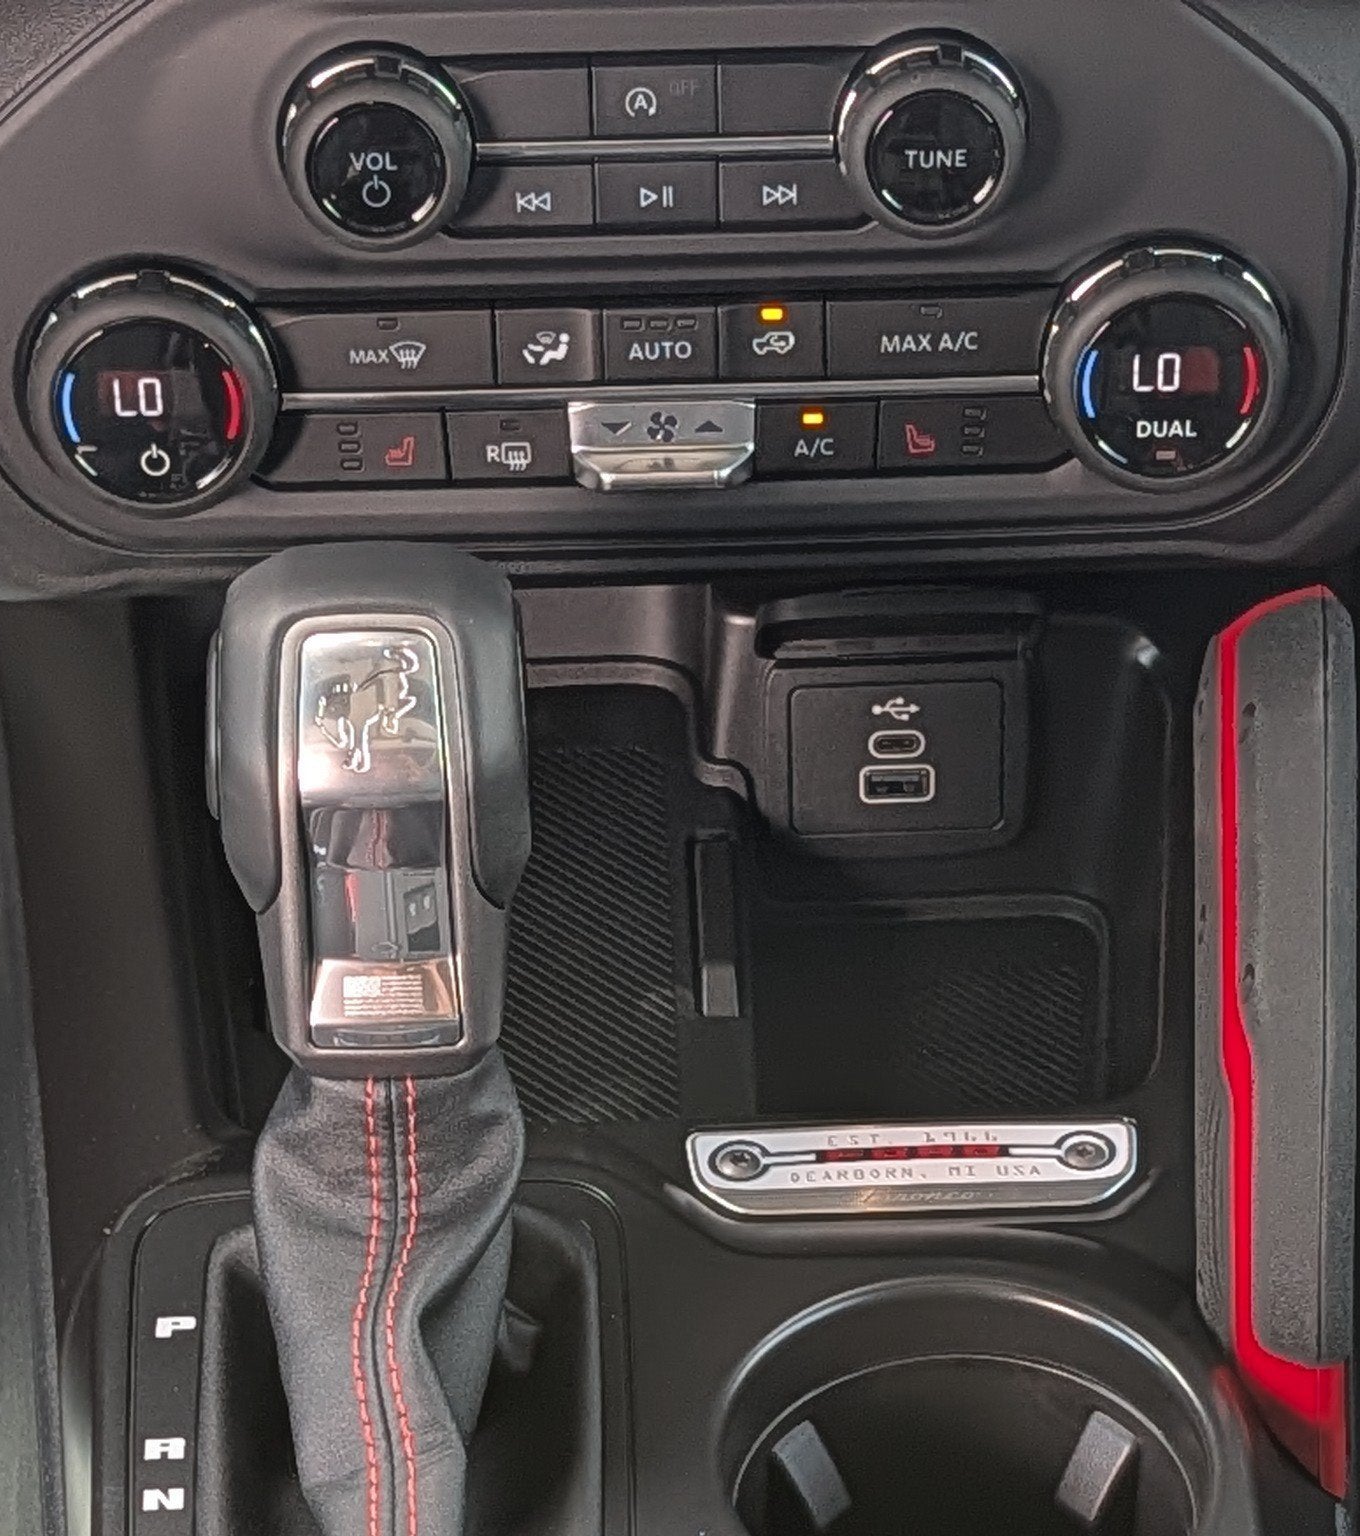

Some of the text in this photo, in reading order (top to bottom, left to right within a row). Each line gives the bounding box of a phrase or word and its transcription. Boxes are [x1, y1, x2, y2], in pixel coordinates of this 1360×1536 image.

[668, 79, 700, 97] OFF
[349, 151, 397, 172] VOL
[904, 148, 968, 170] TUNE
[628, 341, 692, 361] AUTO
[880, 331, 979, 354] MAX A/C
[349, 345, 389, 364] MAX
[1136, 420, 1197, 440] DUAL
[487, 445, 499, 463] R
[794, 438, 834, 458] A/C
[827, 1133, 894, 1148] EST.
[789, 1165, 1042, 1184] DEARBORN, MI USA
[155, 1315, 197, 1339] P
[144, 1437, 186, 1461] R
[142, 1488, 185, 1511] N
